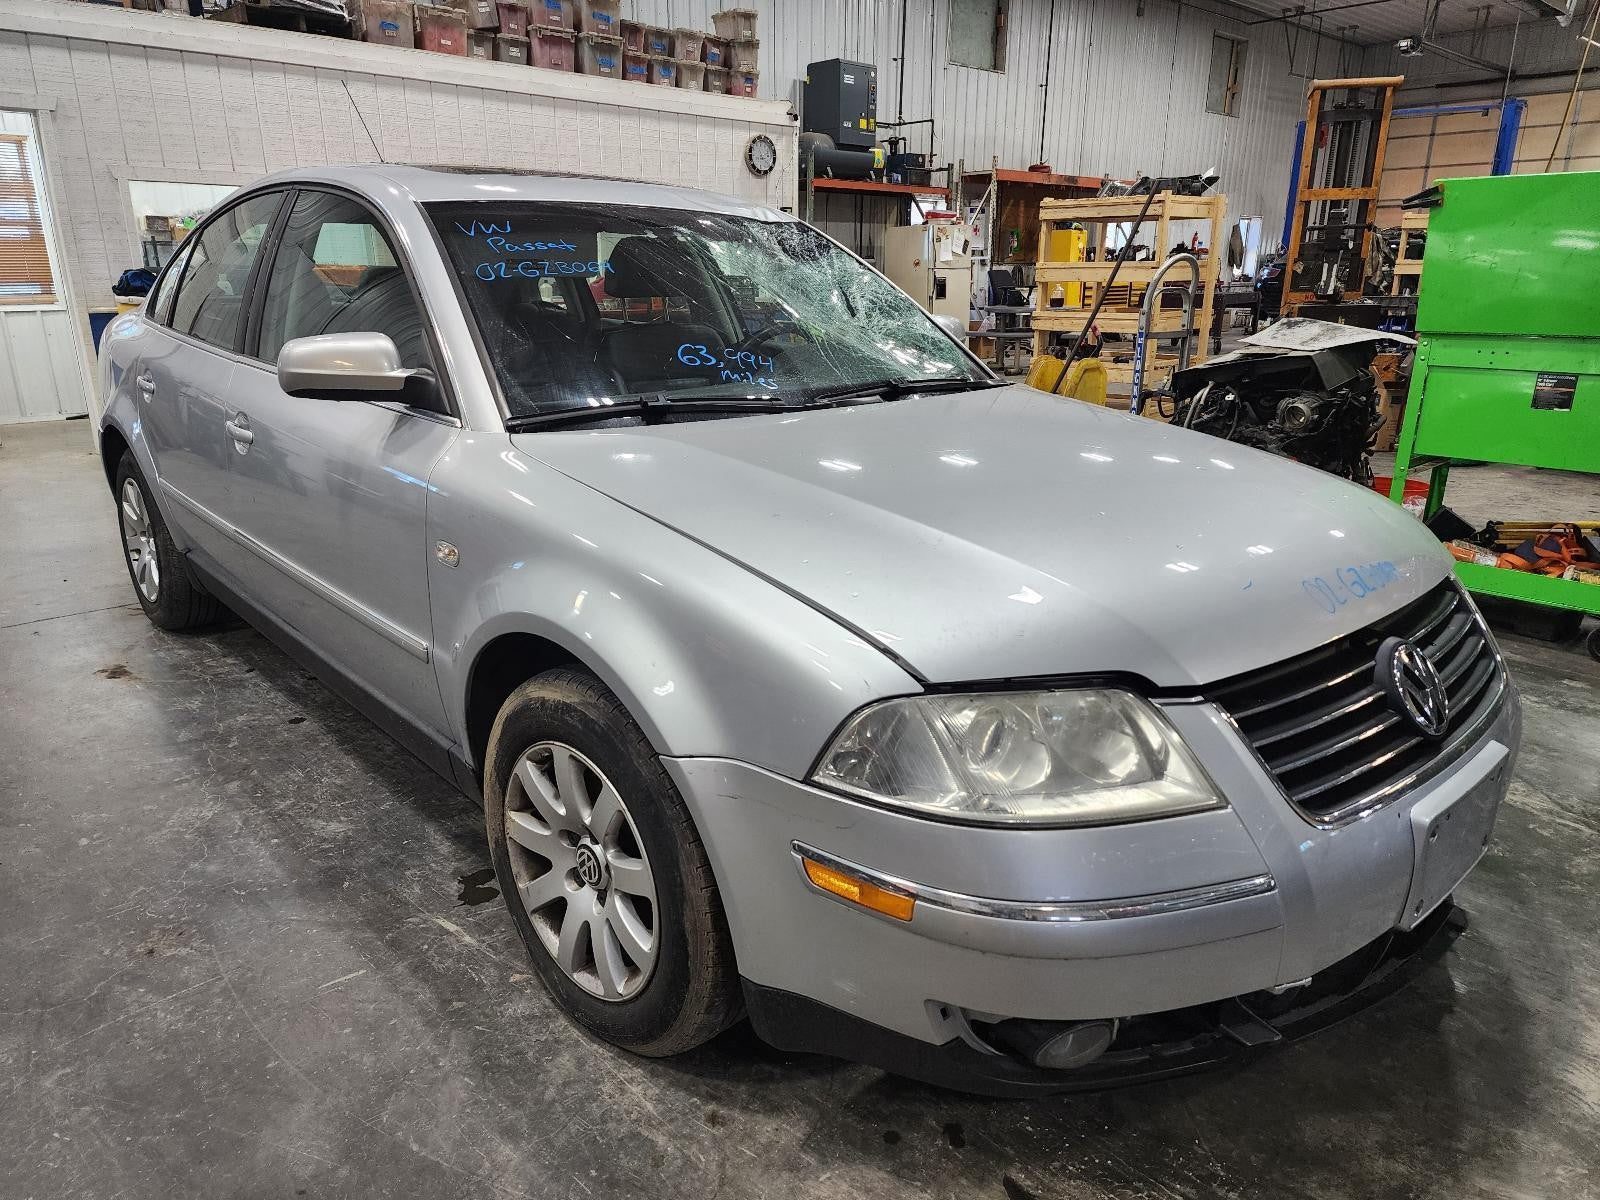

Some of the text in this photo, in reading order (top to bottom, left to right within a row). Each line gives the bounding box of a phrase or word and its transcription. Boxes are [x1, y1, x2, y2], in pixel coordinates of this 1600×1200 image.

[454, 219, 511, 237] VW
[677, 343, 774, 373] 63,994
[720, 369, 779, 390] miles
[576, 847, 600, 883] VW
